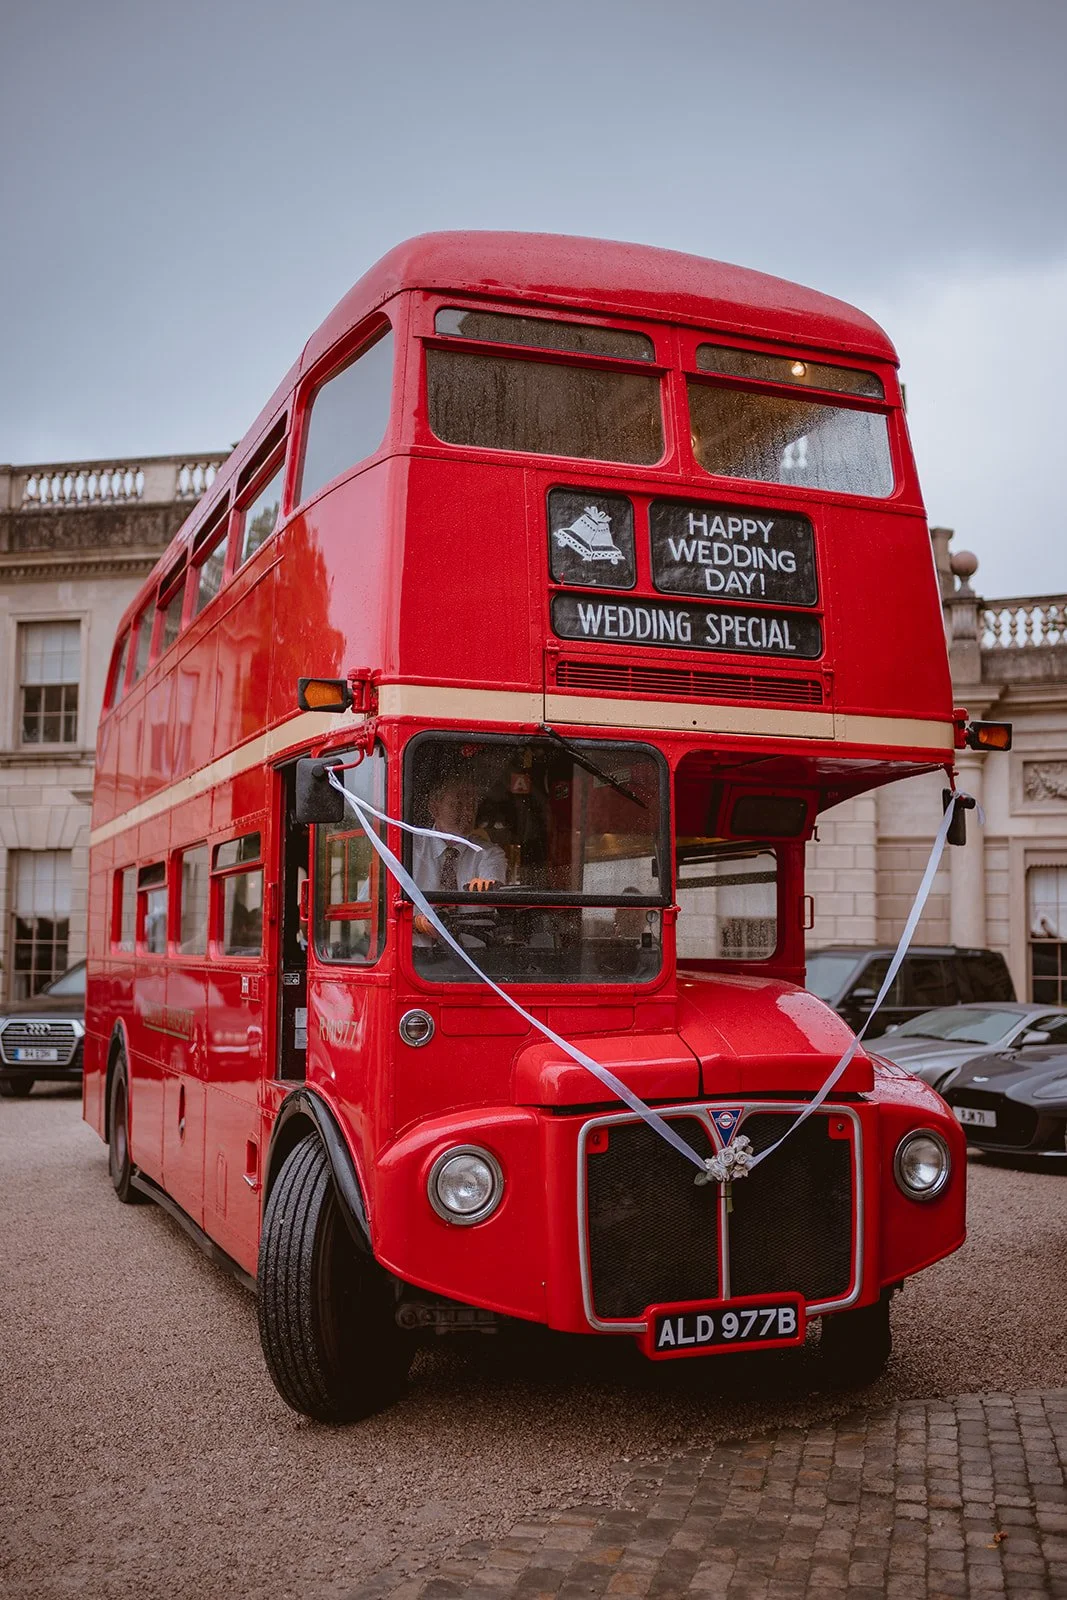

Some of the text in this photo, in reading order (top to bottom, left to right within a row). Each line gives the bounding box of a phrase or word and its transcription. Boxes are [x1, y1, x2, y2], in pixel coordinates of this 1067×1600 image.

[688, 512, 774, 543] HAPPY
[668, 538, 796, 573] WEDDING
[705, 568, 766, 596] DAY!
[577, 603, 796, 650] WEDDING SPECIAL
[658, 1307, 796, 1347] ALD 977B
